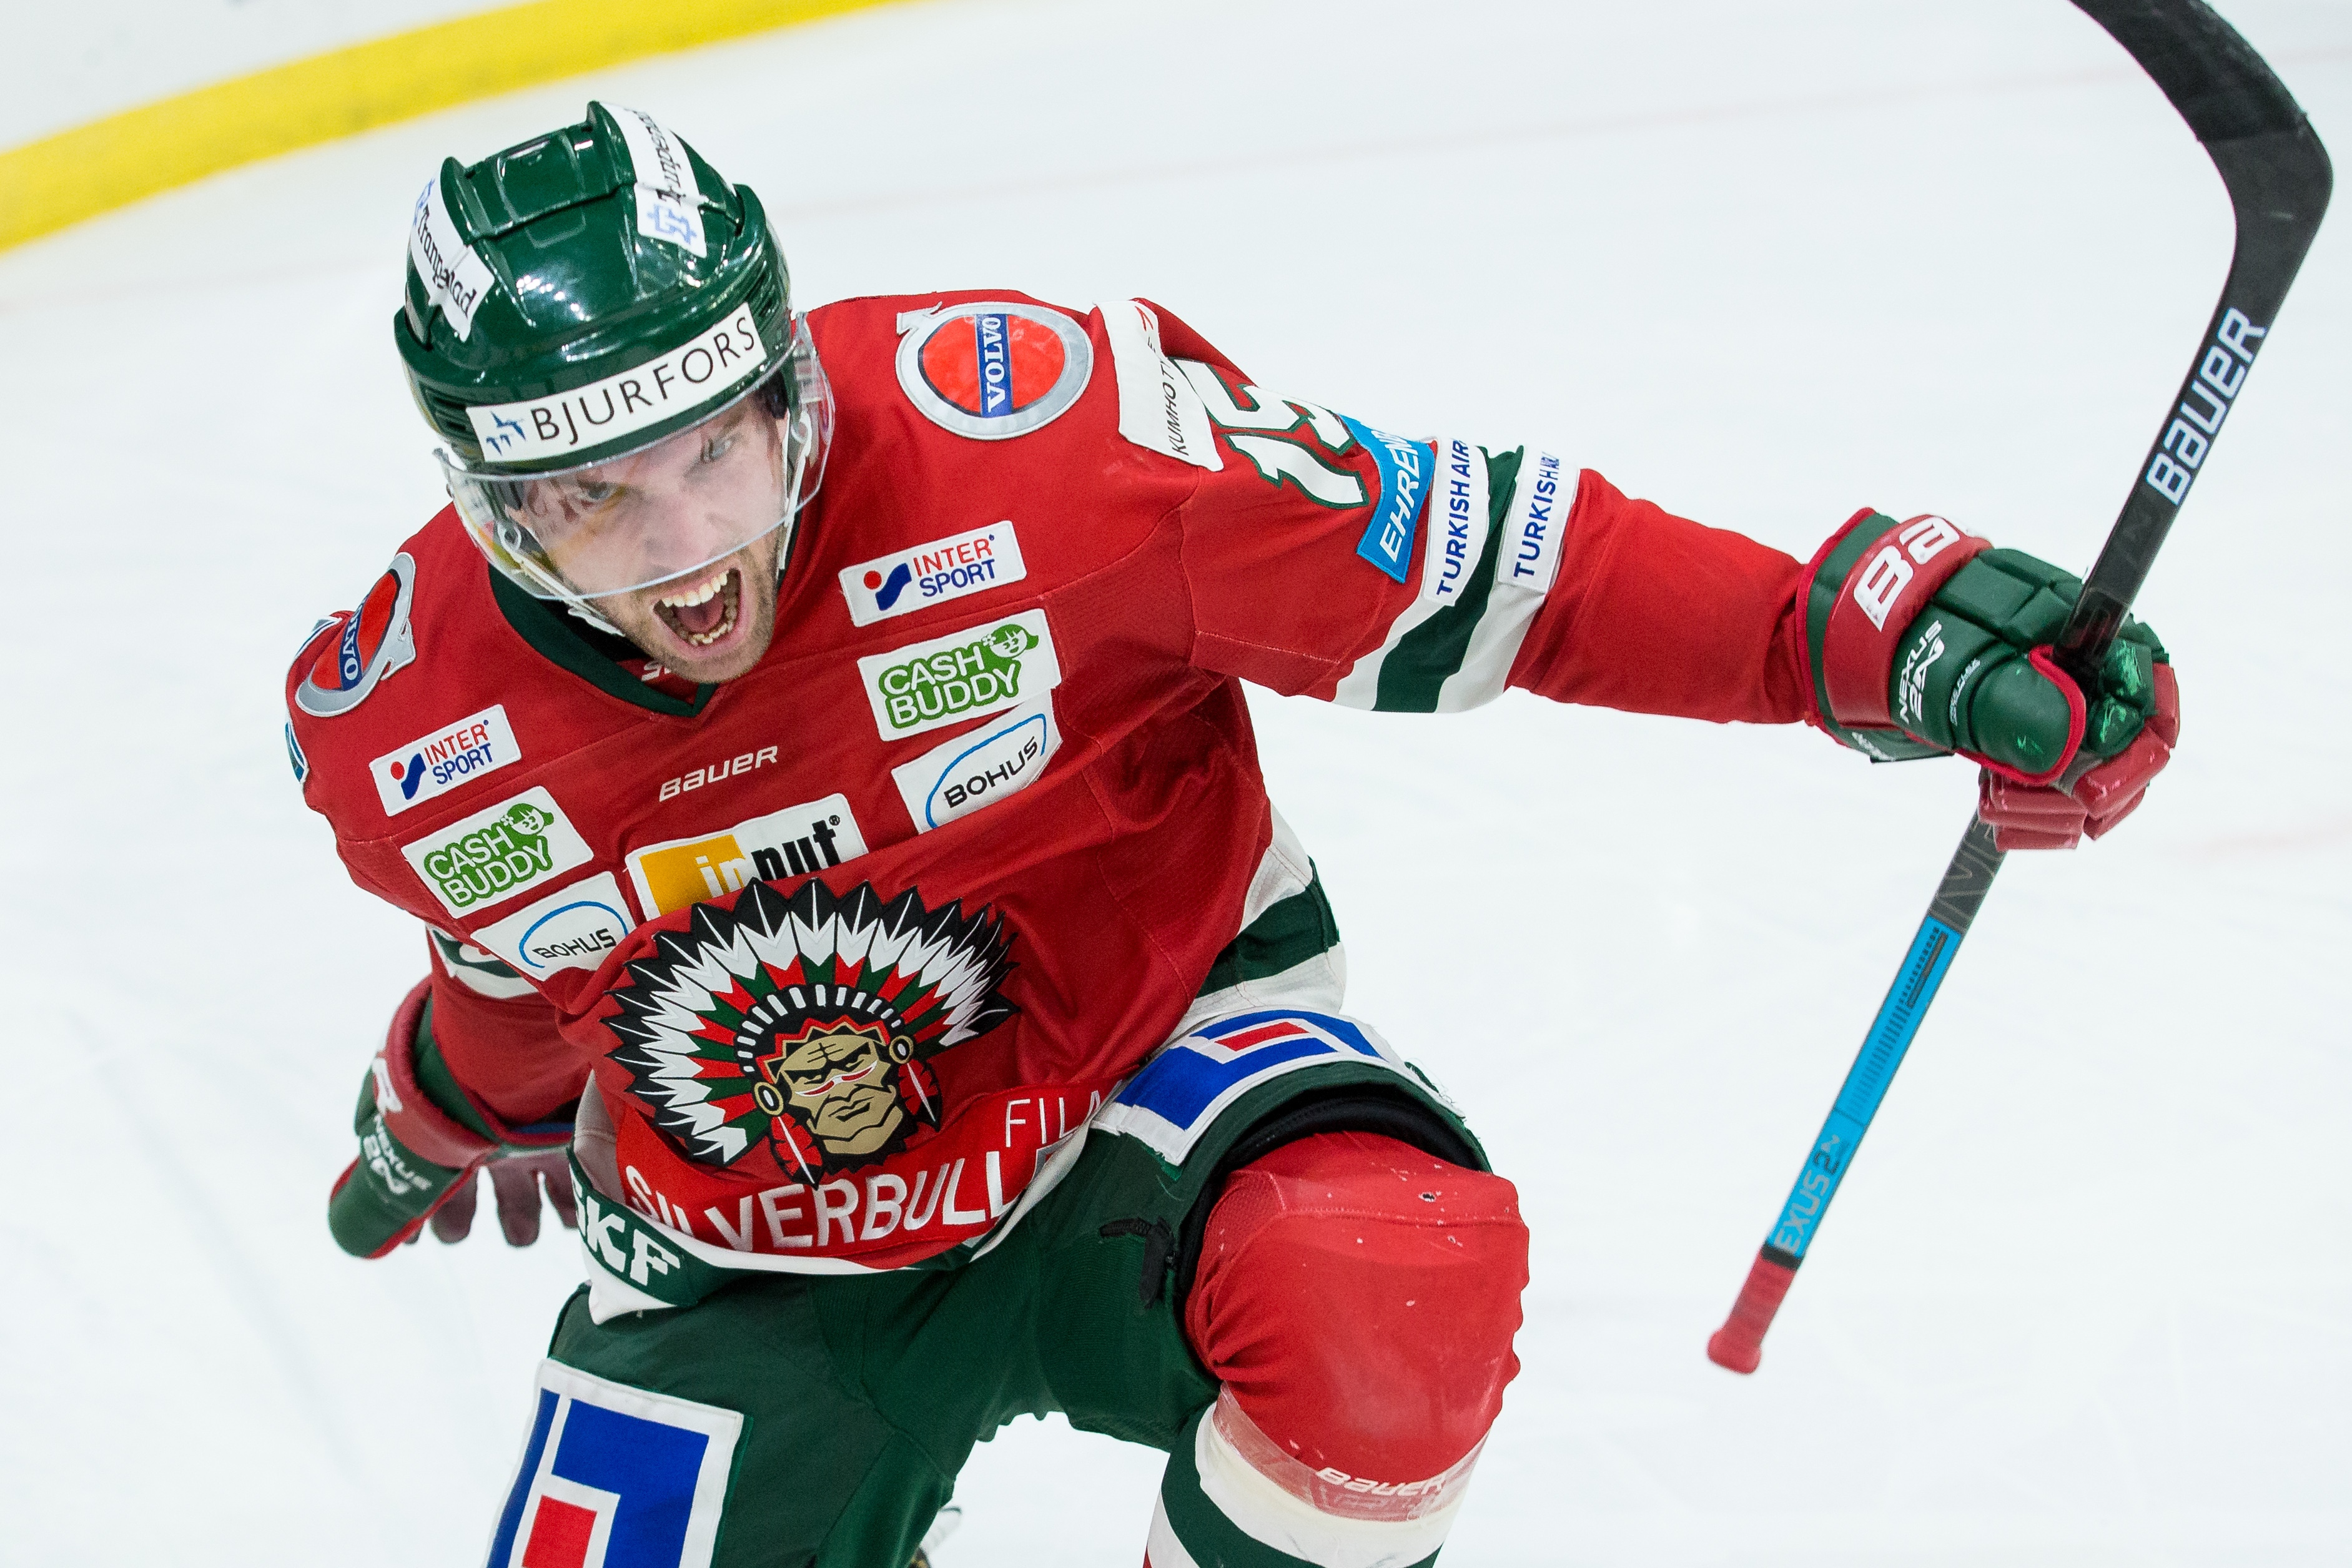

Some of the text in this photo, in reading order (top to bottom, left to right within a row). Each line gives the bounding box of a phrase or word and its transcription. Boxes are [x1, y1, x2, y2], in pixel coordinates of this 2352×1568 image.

[530, 315, 756, 445] BJURFORS
[982, 316, 1007, 413] VOLVO
[1162, 382, 1190, 456] KUMHO
[2145, 306, 2267, 506] BAUER
[1436, 438, 1471, 596] TURKISH AIR
[1513, 468, 1559, 578] TURKISH
[913, 537, 993, 578] INTER
[919, 559, 996, 598] SPORT
[883, 646, 985, 695] CASH
[891, 663, 1017, 724] BUDDY
[424, 724, 489, 766] INTER
[432, 743, 494, 785] SPORT
[659, 745, 779, 802] BAUER
[943, 736, 1038, 808] BOHUS
[428, 823, 515, 880] CASH
[445, 839, 548, 904] BUDDY
[532, 927, 618, 959] BOHUS
[1315, 1467, 1446, 1497] BAUER
